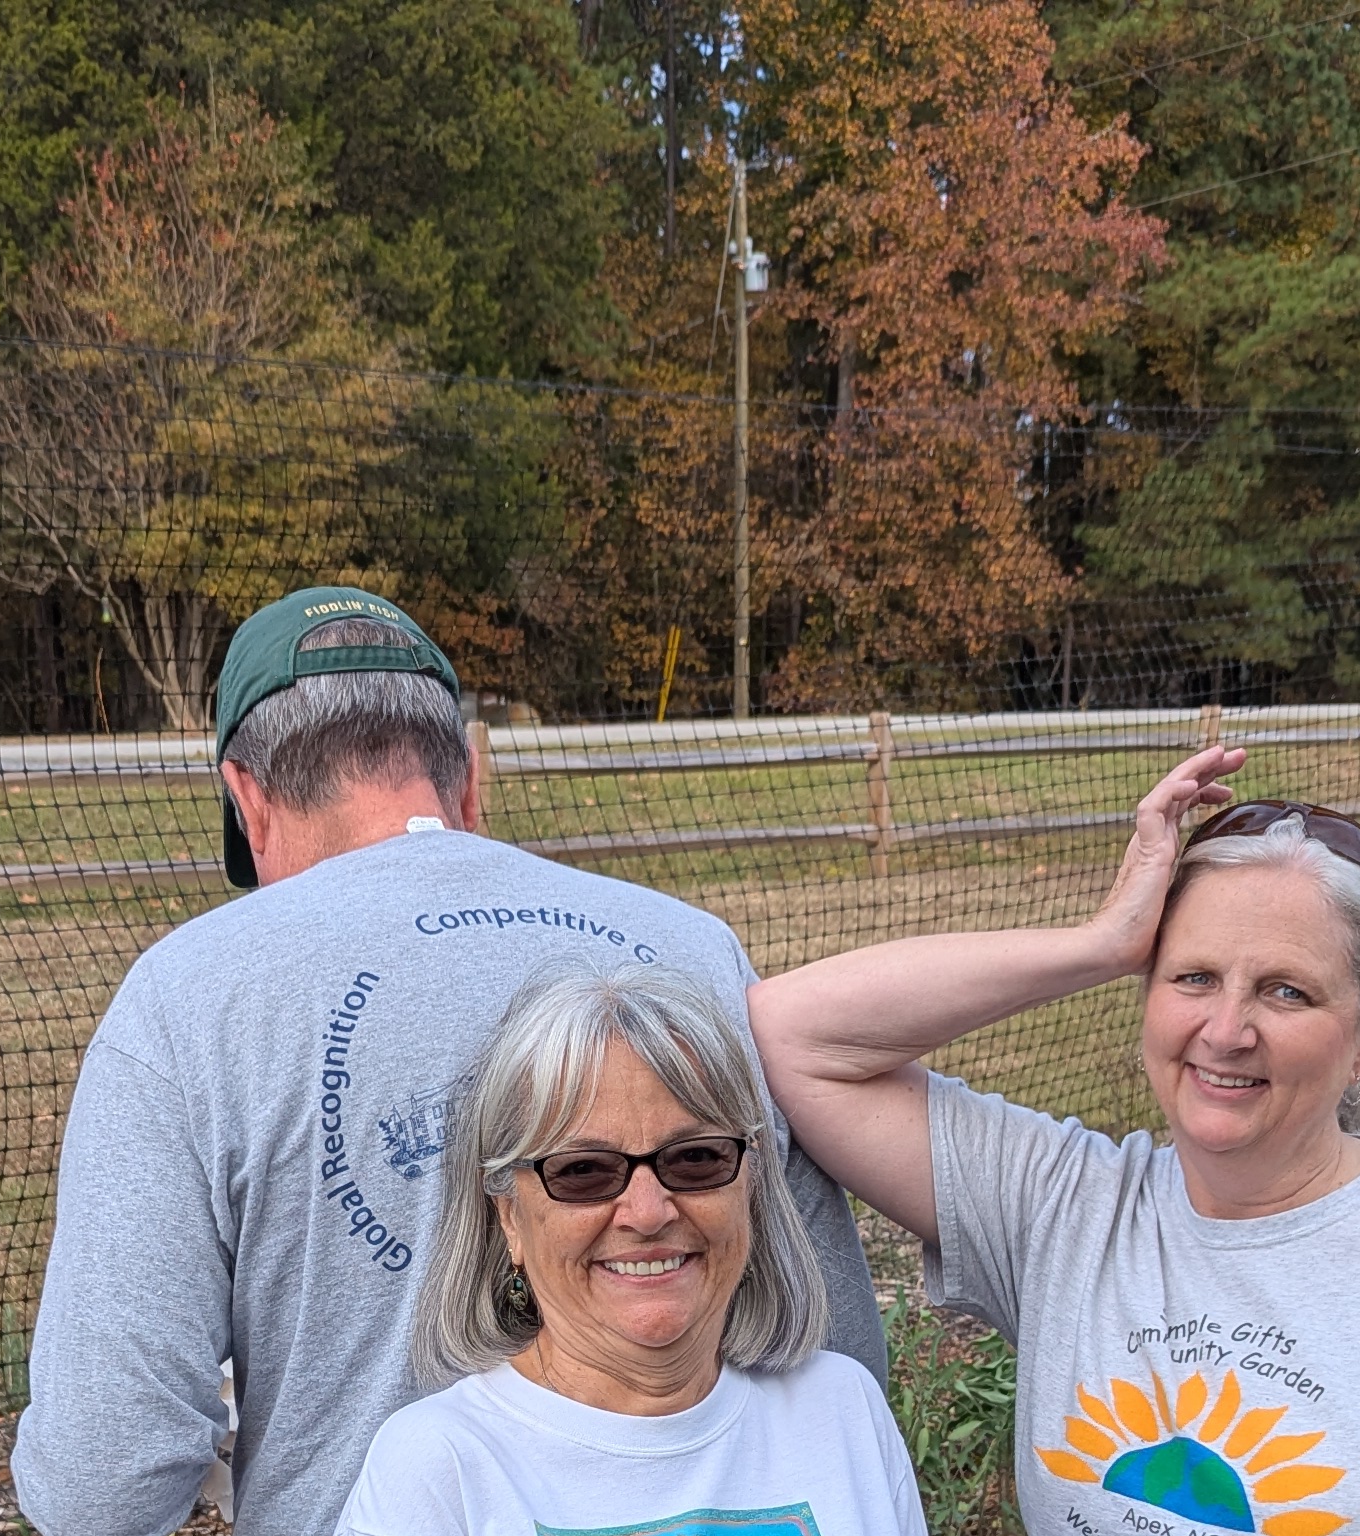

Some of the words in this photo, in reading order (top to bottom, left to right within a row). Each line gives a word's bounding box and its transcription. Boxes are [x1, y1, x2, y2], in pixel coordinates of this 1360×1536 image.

[304, 600, 365, 618] FIDDLIN'
[414, 906, 626, 947] Competitive
[321, 970, 380, 1181] Recognition
[327, 1180, 413, 1272] Global
[1231, 1322, 1296, 1356] Gifts
[1240, 1352, 1326, 1402] Garden
